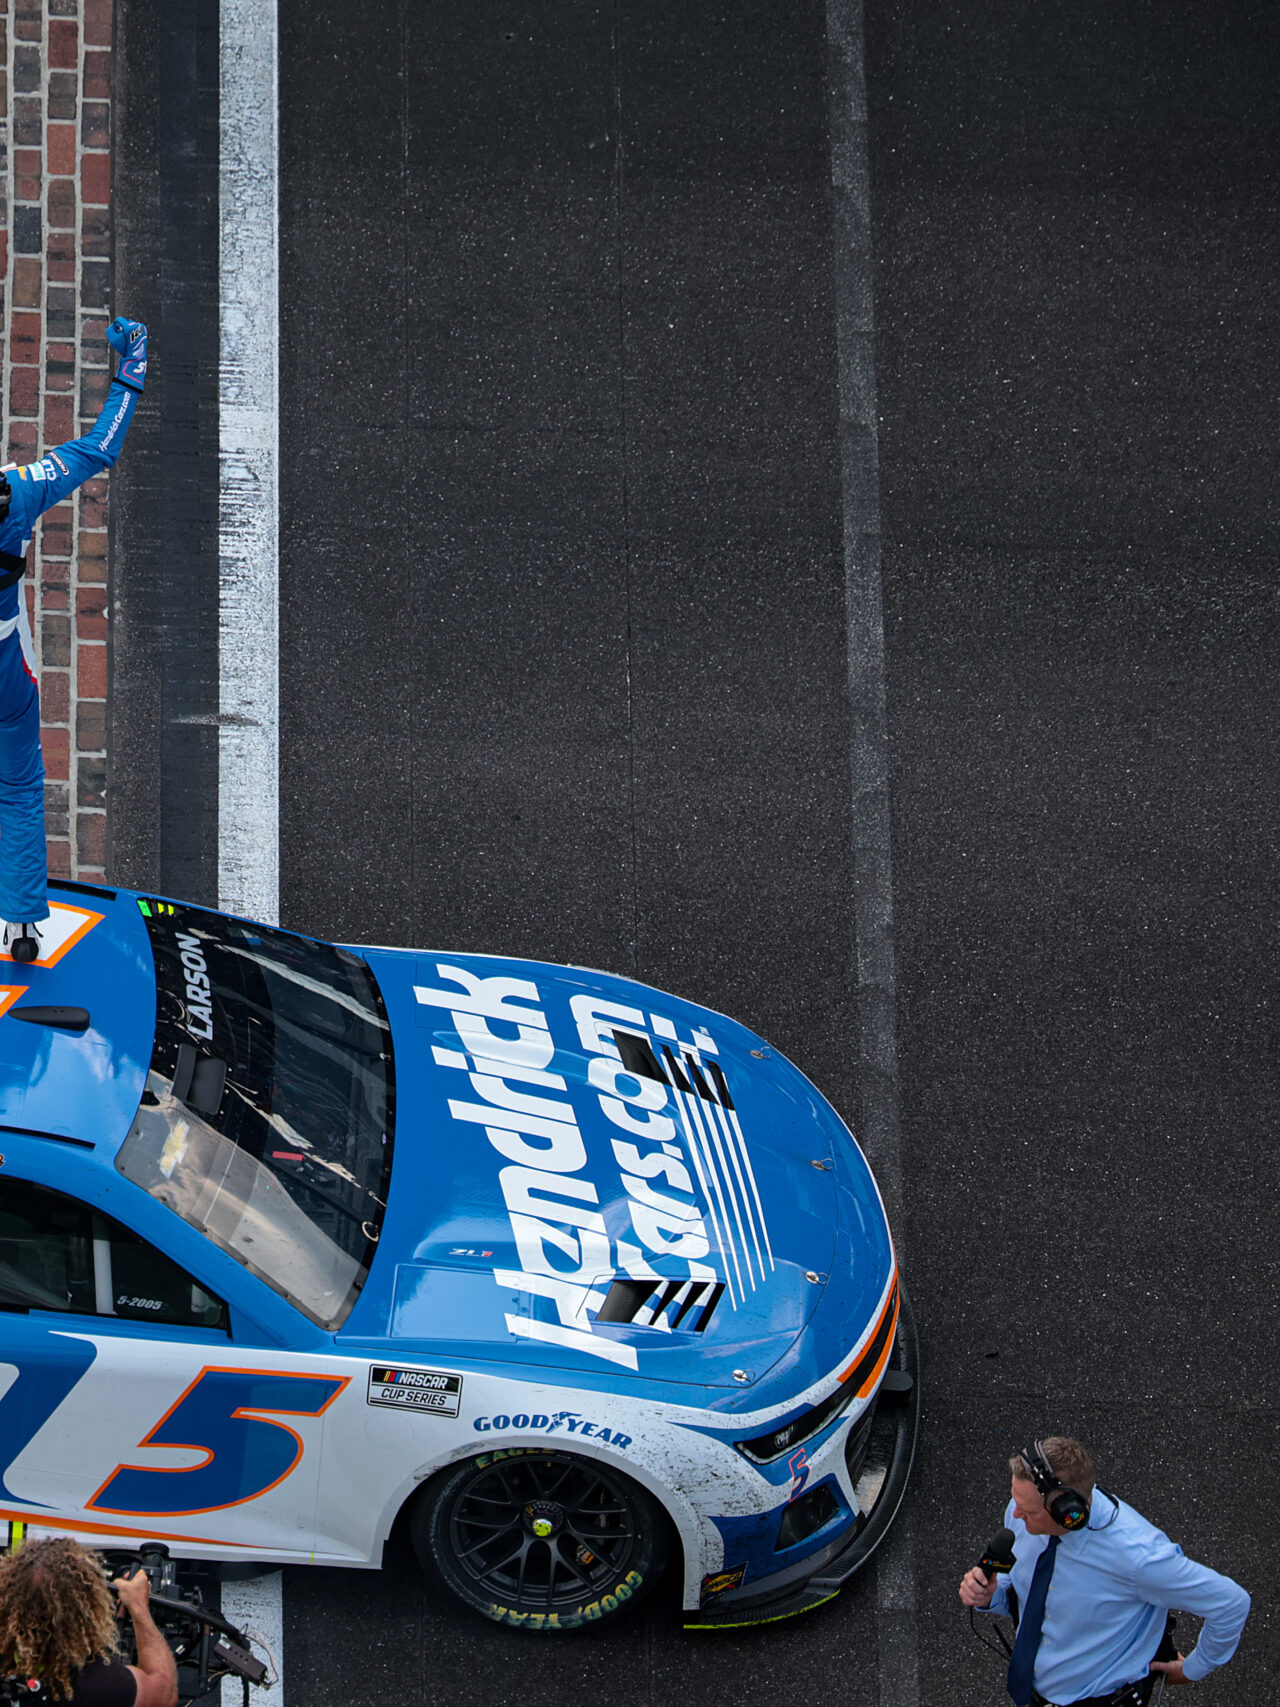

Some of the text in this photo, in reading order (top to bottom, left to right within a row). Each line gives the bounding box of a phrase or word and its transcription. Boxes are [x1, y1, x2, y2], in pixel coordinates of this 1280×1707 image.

[175, 932, 213, 1040] LARSON
[117, 1296, 163, 1310] 5-2005
[381, 1388, 447, 1406] CUP SERIES
[398, 1372, 448, 1390] NASCAR
[83, 1365, 354, 1518] 5
[788, 1447, 811, 1503] 5
